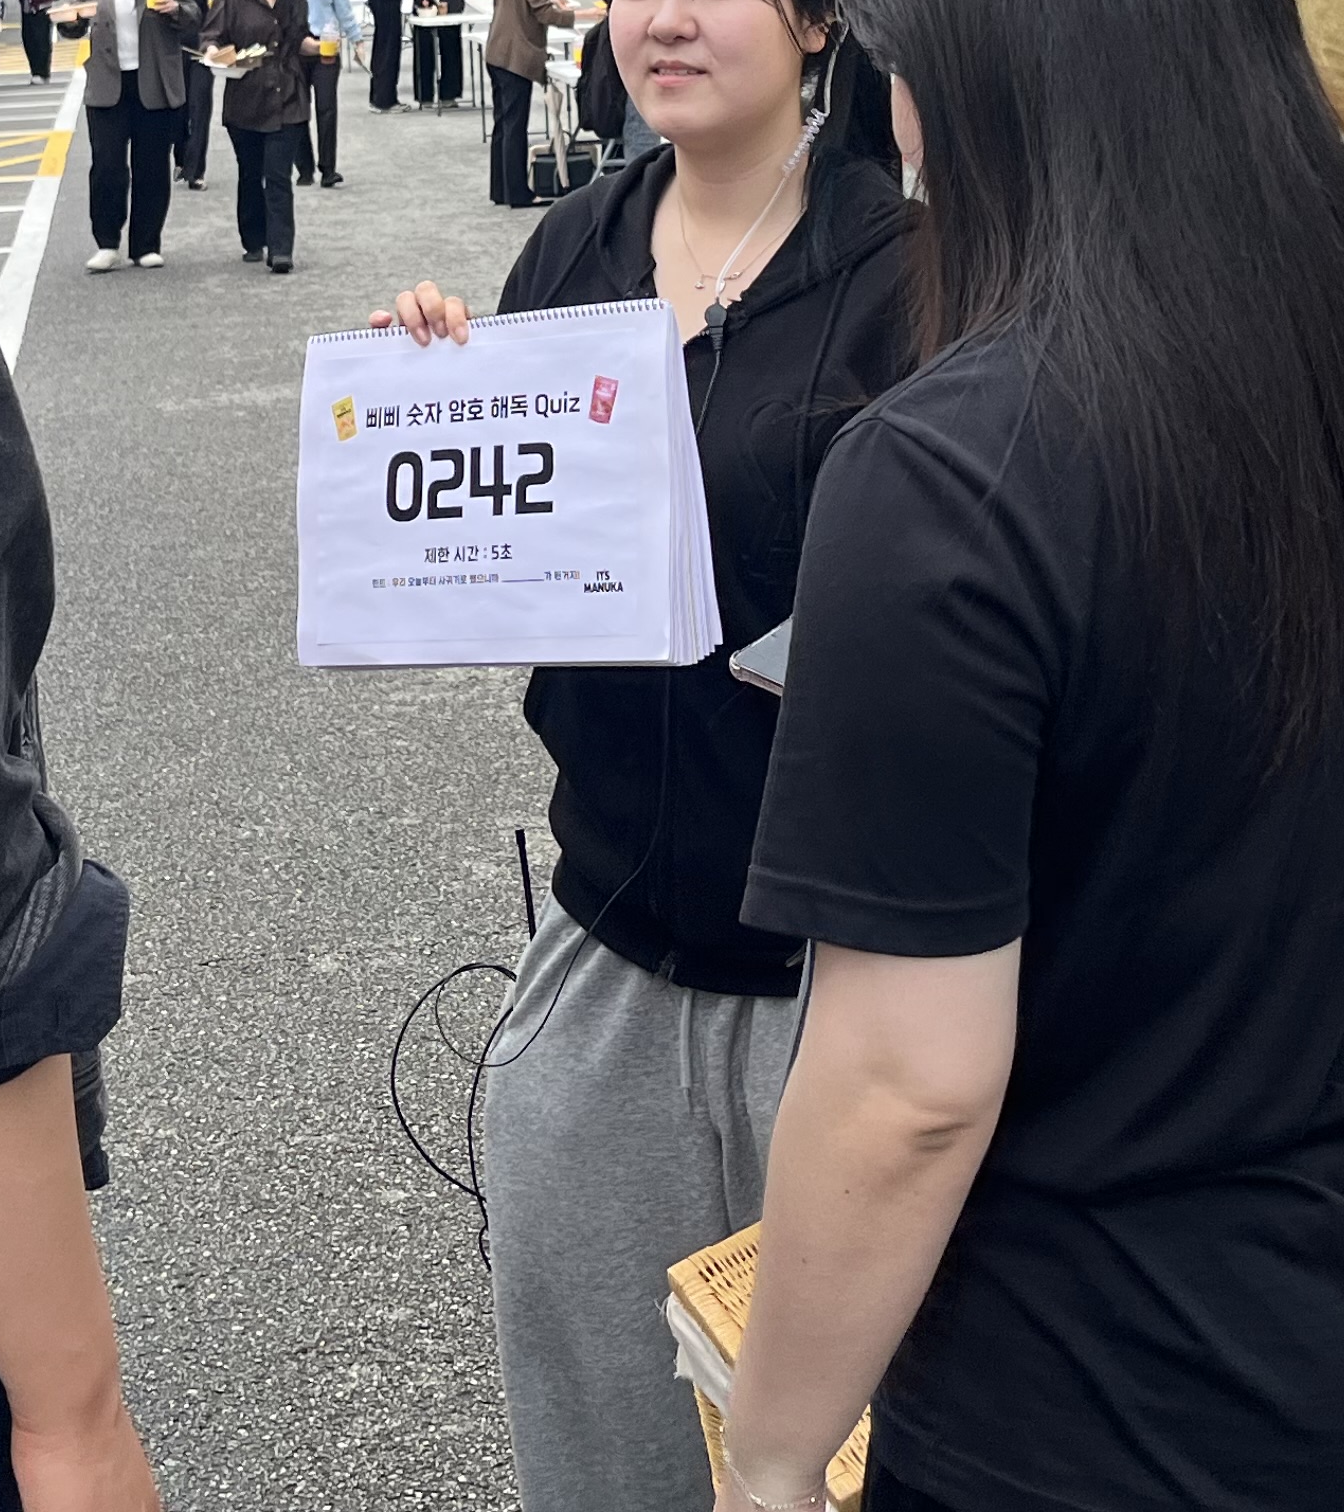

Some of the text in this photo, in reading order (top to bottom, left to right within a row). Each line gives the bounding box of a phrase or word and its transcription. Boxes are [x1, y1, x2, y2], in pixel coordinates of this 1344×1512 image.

[365, 404, 401, 429] 삐삐
[406, 401, 443, 427] 숫자
[448, 397, 485, 424] 암호
[490, 393, 529, 419] 해독
[534, 390, 581, 419] Quiz
[386, 441, 554, 523] 0242
[424, 545, 451, 564] 제한
[453, 544, 479, 563] 시간
[491, 542, 513, 561] 5초
[391, 576, 406, 588] 우리
[407, 574, 437, 587] 오늘부터
[596, 570, 611, 581] ITS
[582, 581, 624, 594] MANUKA
